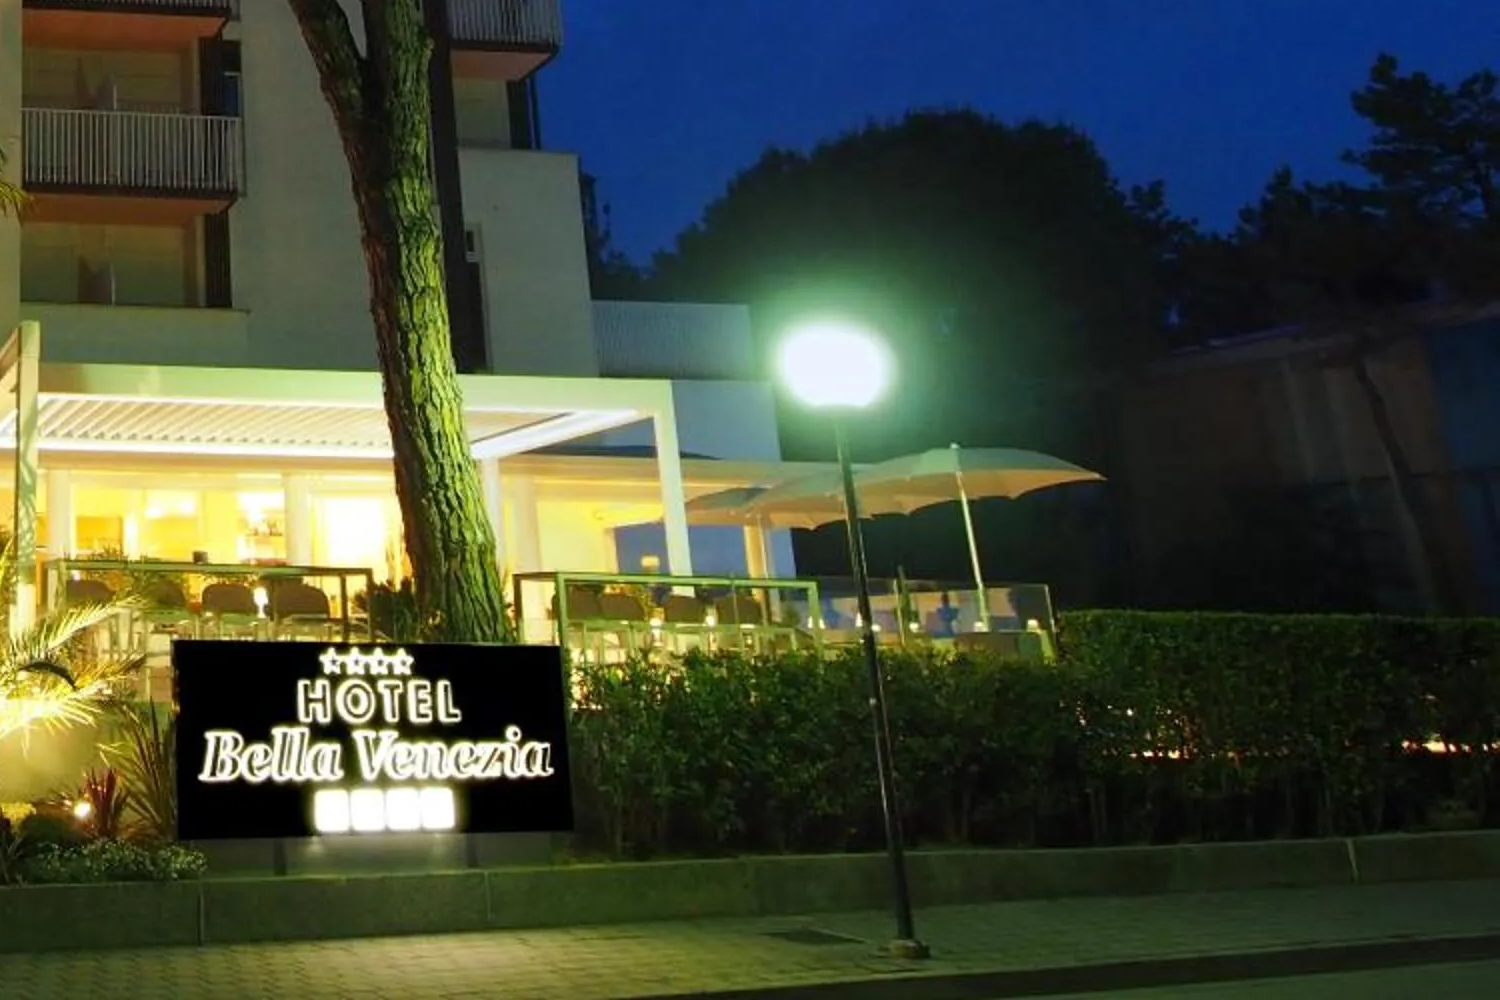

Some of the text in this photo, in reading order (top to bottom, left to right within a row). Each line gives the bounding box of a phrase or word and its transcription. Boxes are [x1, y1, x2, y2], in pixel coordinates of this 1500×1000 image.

[297, 679, 462, 723] HOTEL
[199, 725, 554, 782] Bella Venezia
